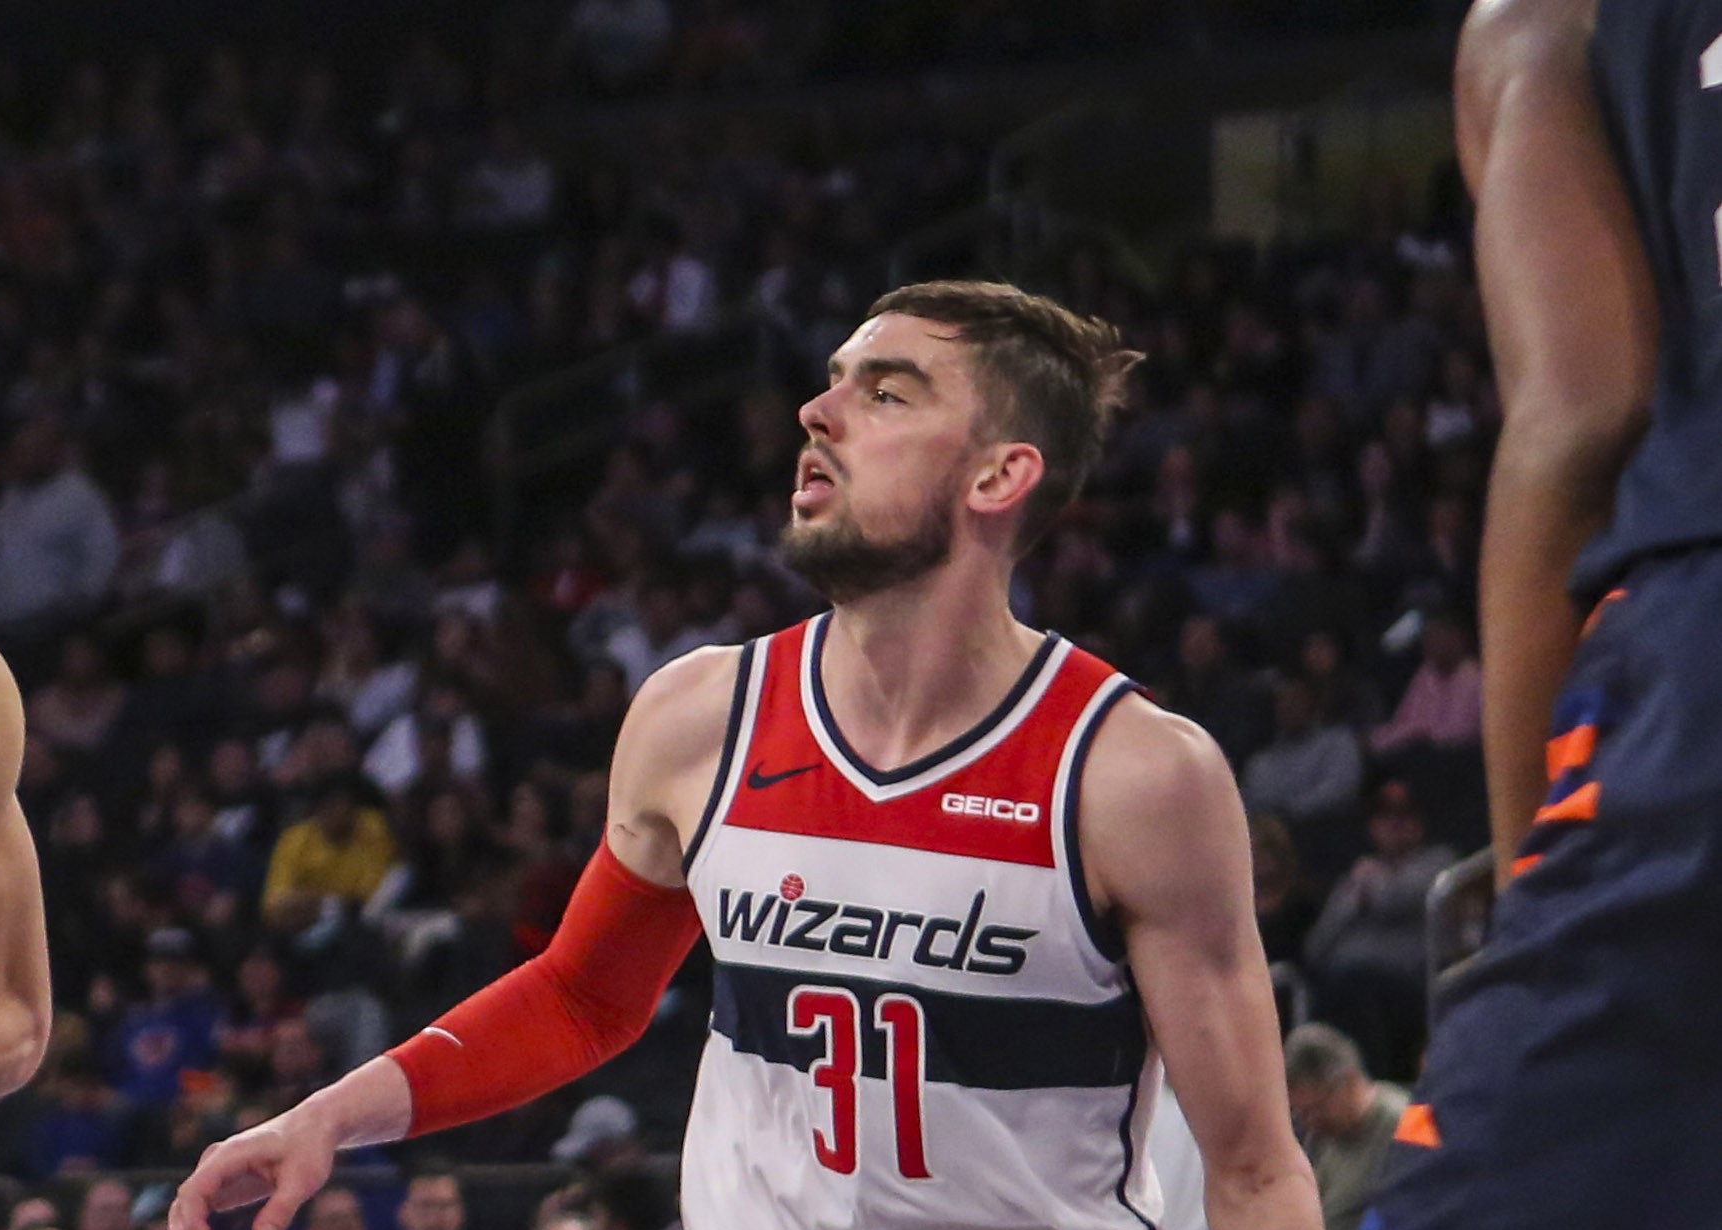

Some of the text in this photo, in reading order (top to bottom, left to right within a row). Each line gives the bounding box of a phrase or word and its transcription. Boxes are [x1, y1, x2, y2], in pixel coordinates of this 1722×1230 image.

[940, 792, 1040, 824] GEICO
[717, 872, 1041, 976] wizards
[786, 985, 934, 1179] 31
